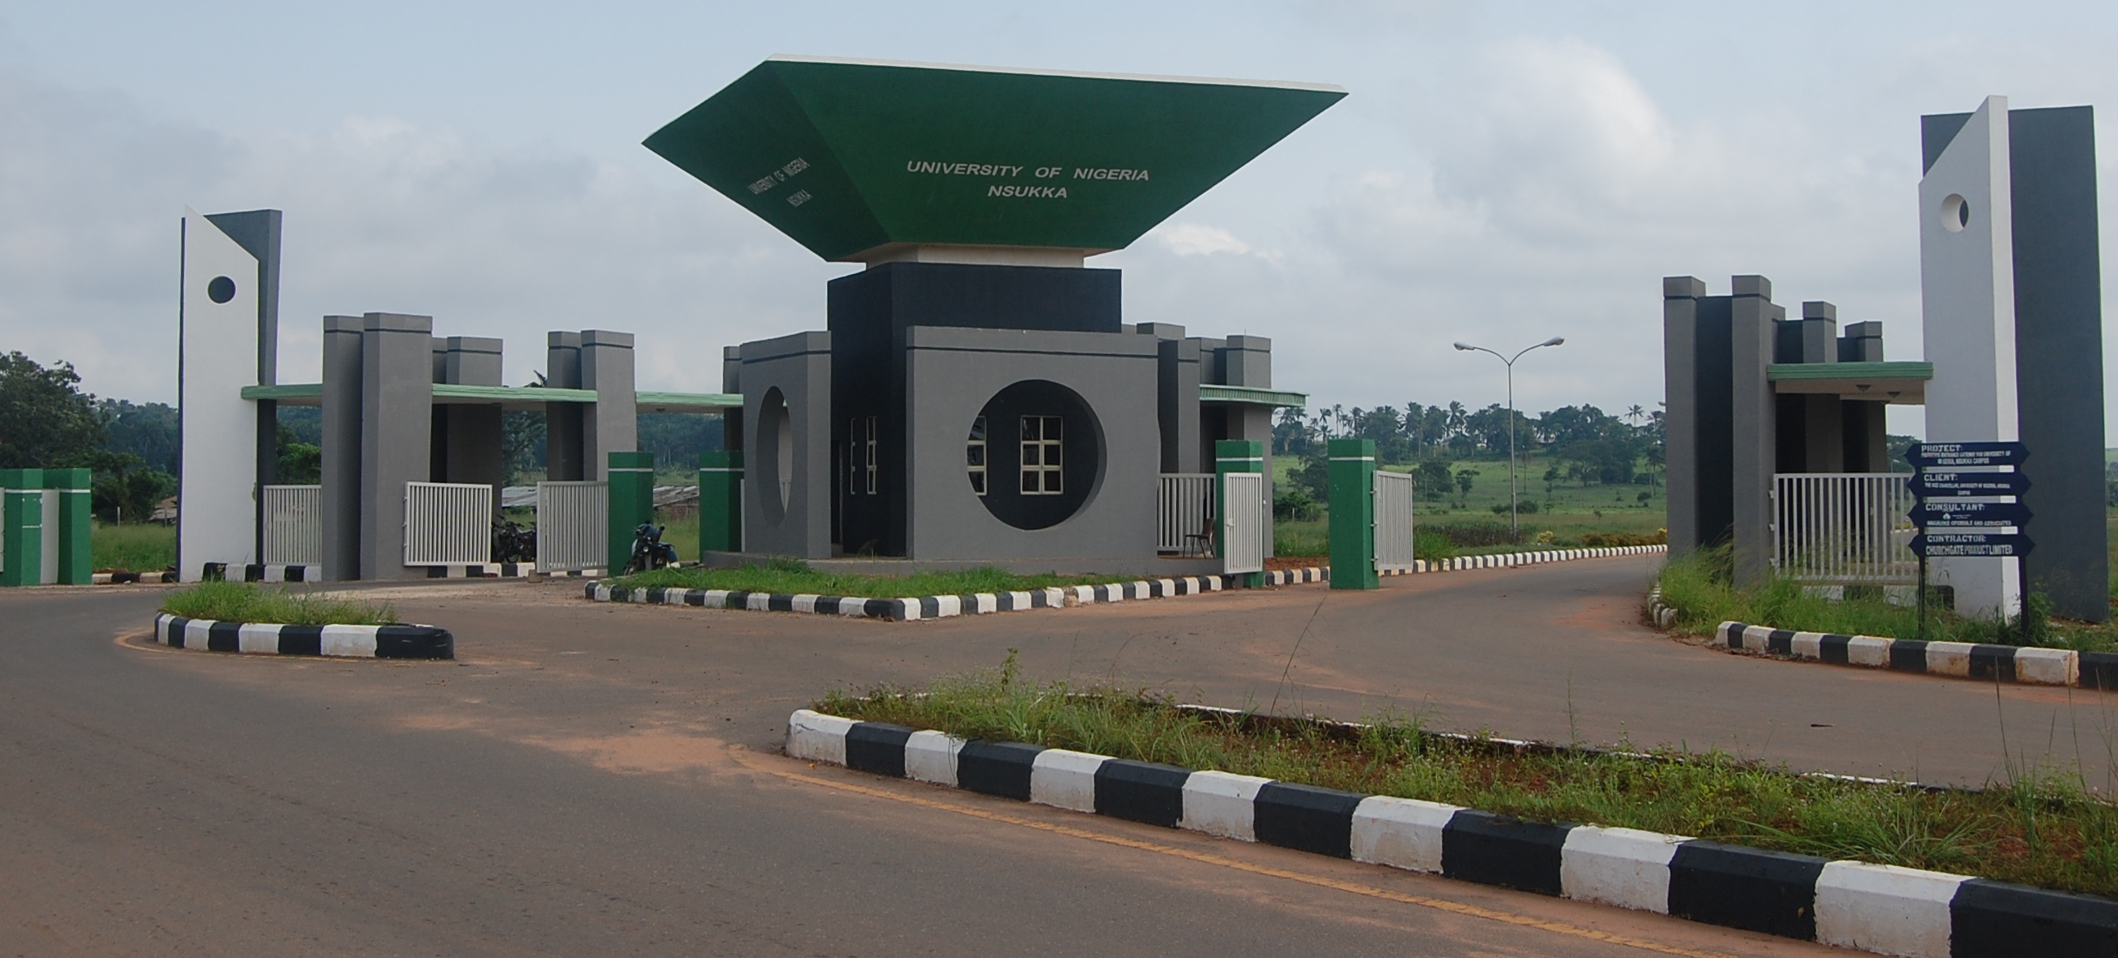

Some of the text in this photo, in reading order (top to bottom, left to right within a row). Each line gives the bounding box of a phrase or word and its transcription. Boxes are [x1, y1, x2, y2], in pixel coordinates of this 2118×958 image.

[906, 160, 1150, 181] UNIVERSITY OF NIGERIA
[988, 185, 1068, 198] NSUKKA
[1990, 544, 2012, 554] LIMITED
